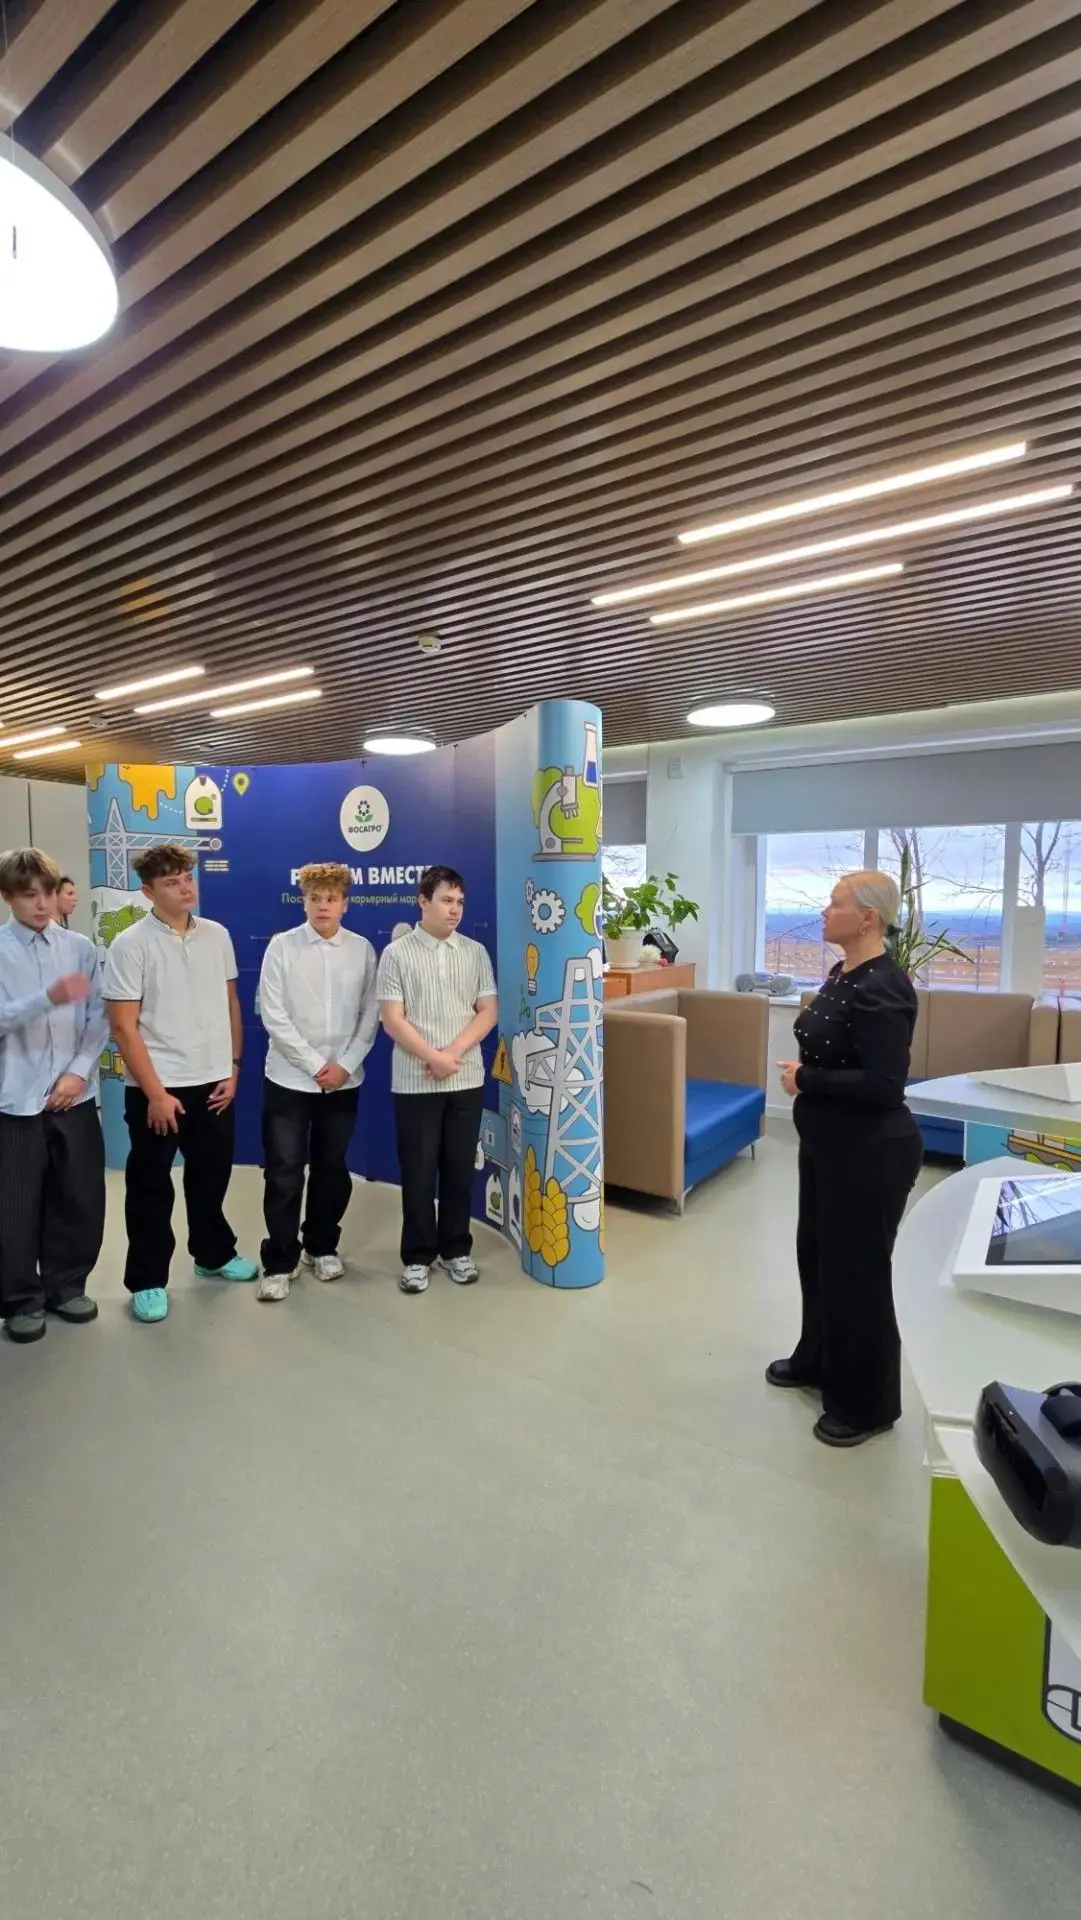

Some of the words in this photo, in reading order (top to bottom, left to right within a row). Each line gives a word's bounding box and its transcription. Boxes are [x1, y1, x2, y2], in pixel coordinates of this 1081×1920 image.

[348, 825, 382, 833] ФОСАГРО
[368, 865, 433, 885] ВМЕСТ
[351, 892, 398, 906] карьерный
